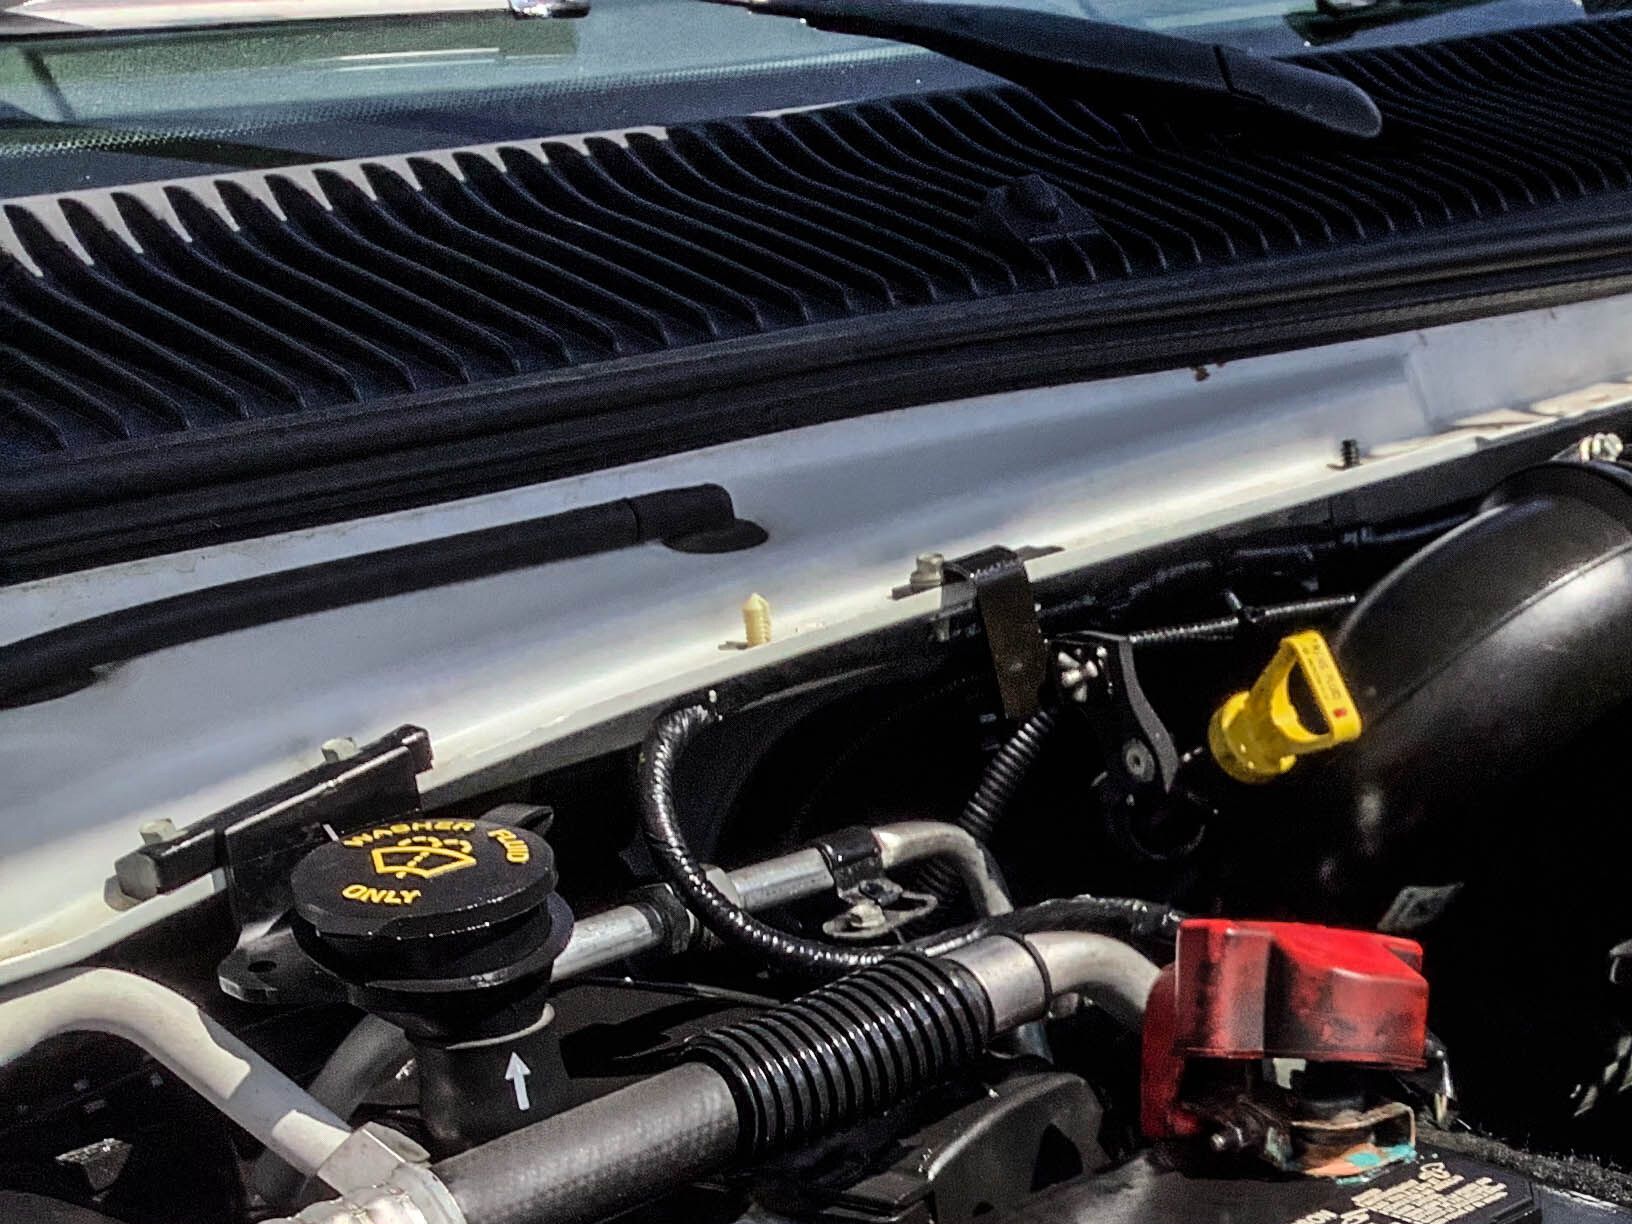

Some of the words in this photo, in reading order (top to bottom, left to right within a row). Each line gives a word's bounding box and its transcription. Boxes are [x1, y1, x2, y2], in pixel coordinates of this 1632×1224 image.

[343, 821, 476, 848] WASHER
[487, 828, 530, 863] FLUID
[342, 884, 421, 904] ONLY
